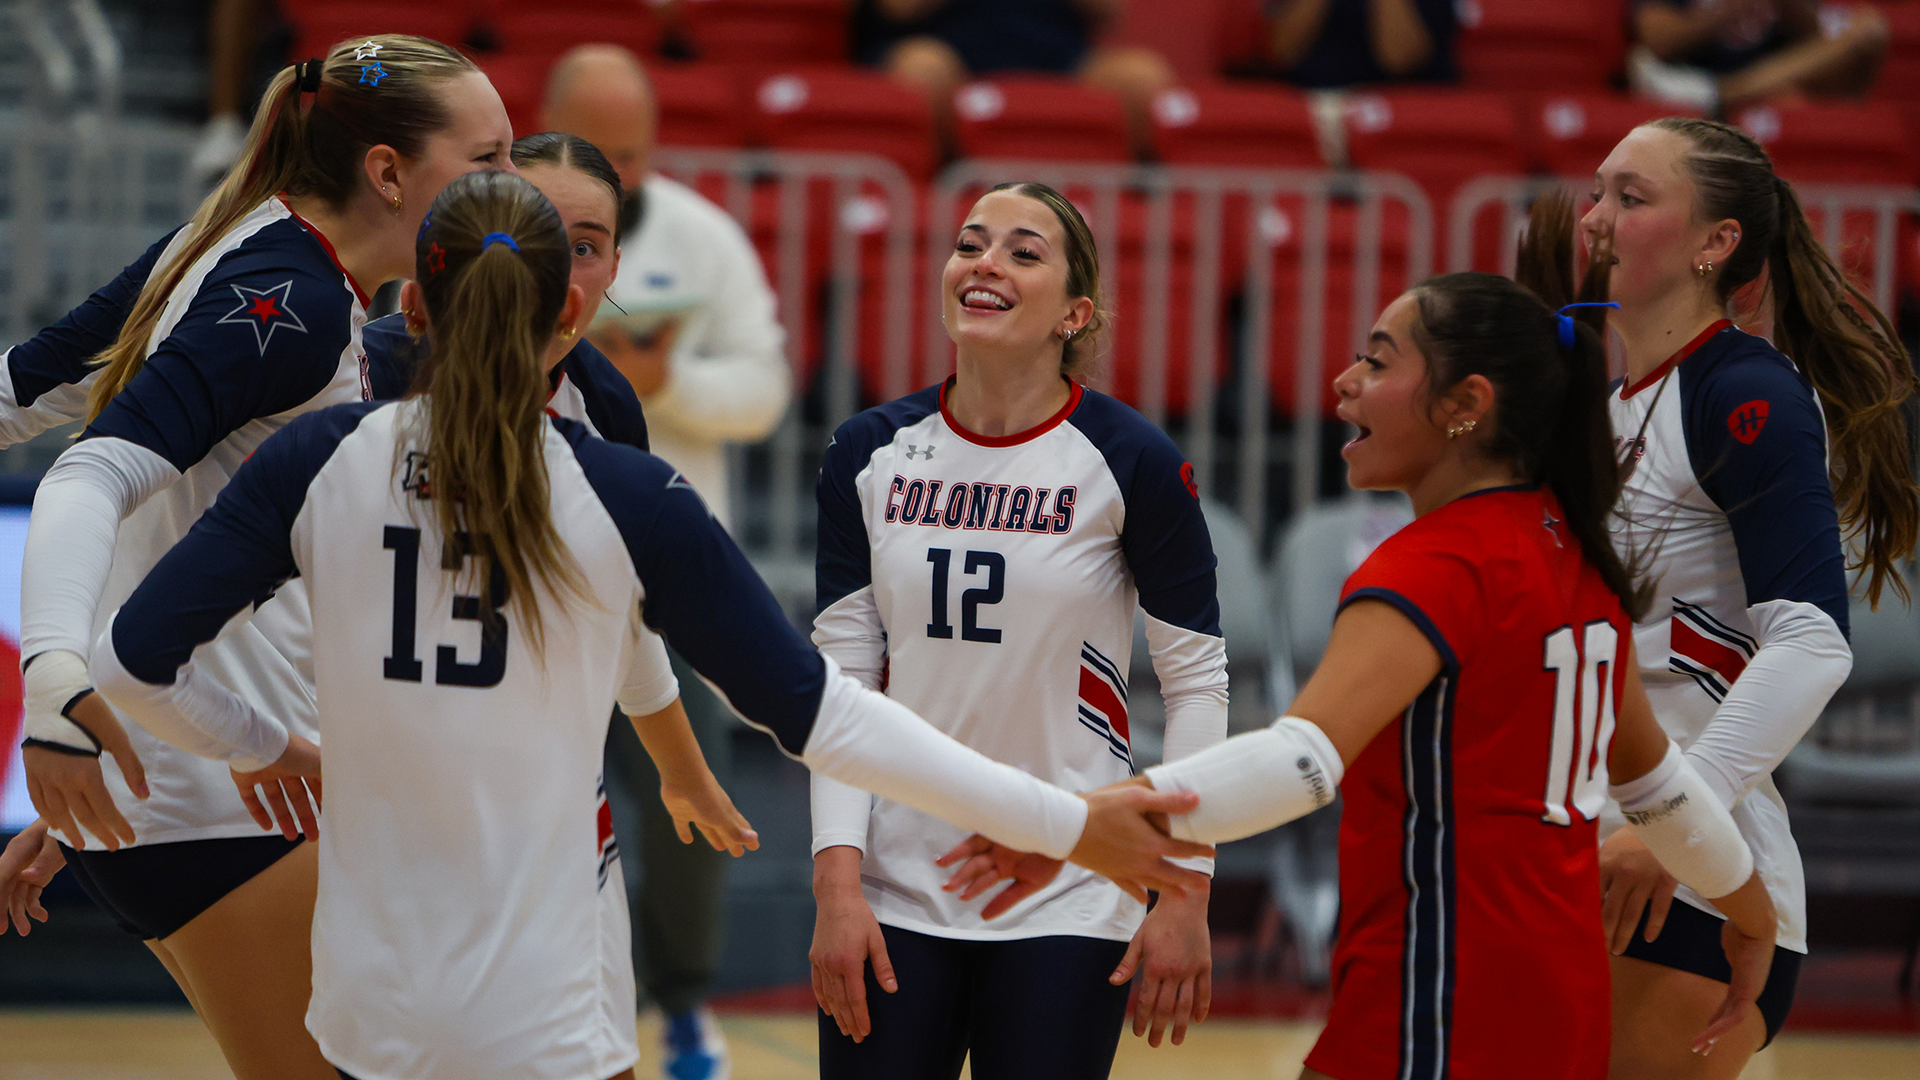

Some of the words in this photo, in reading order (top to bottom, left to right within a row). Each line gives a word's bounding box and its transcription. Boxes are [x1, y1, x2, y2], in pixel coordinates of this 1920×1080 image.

[885, 474, 1077, 535] COLONIALS
[383, 525, 509, 689] 13
[926, 547, 1006, 644] 12
[1542, 618, 1618, 827] 10
